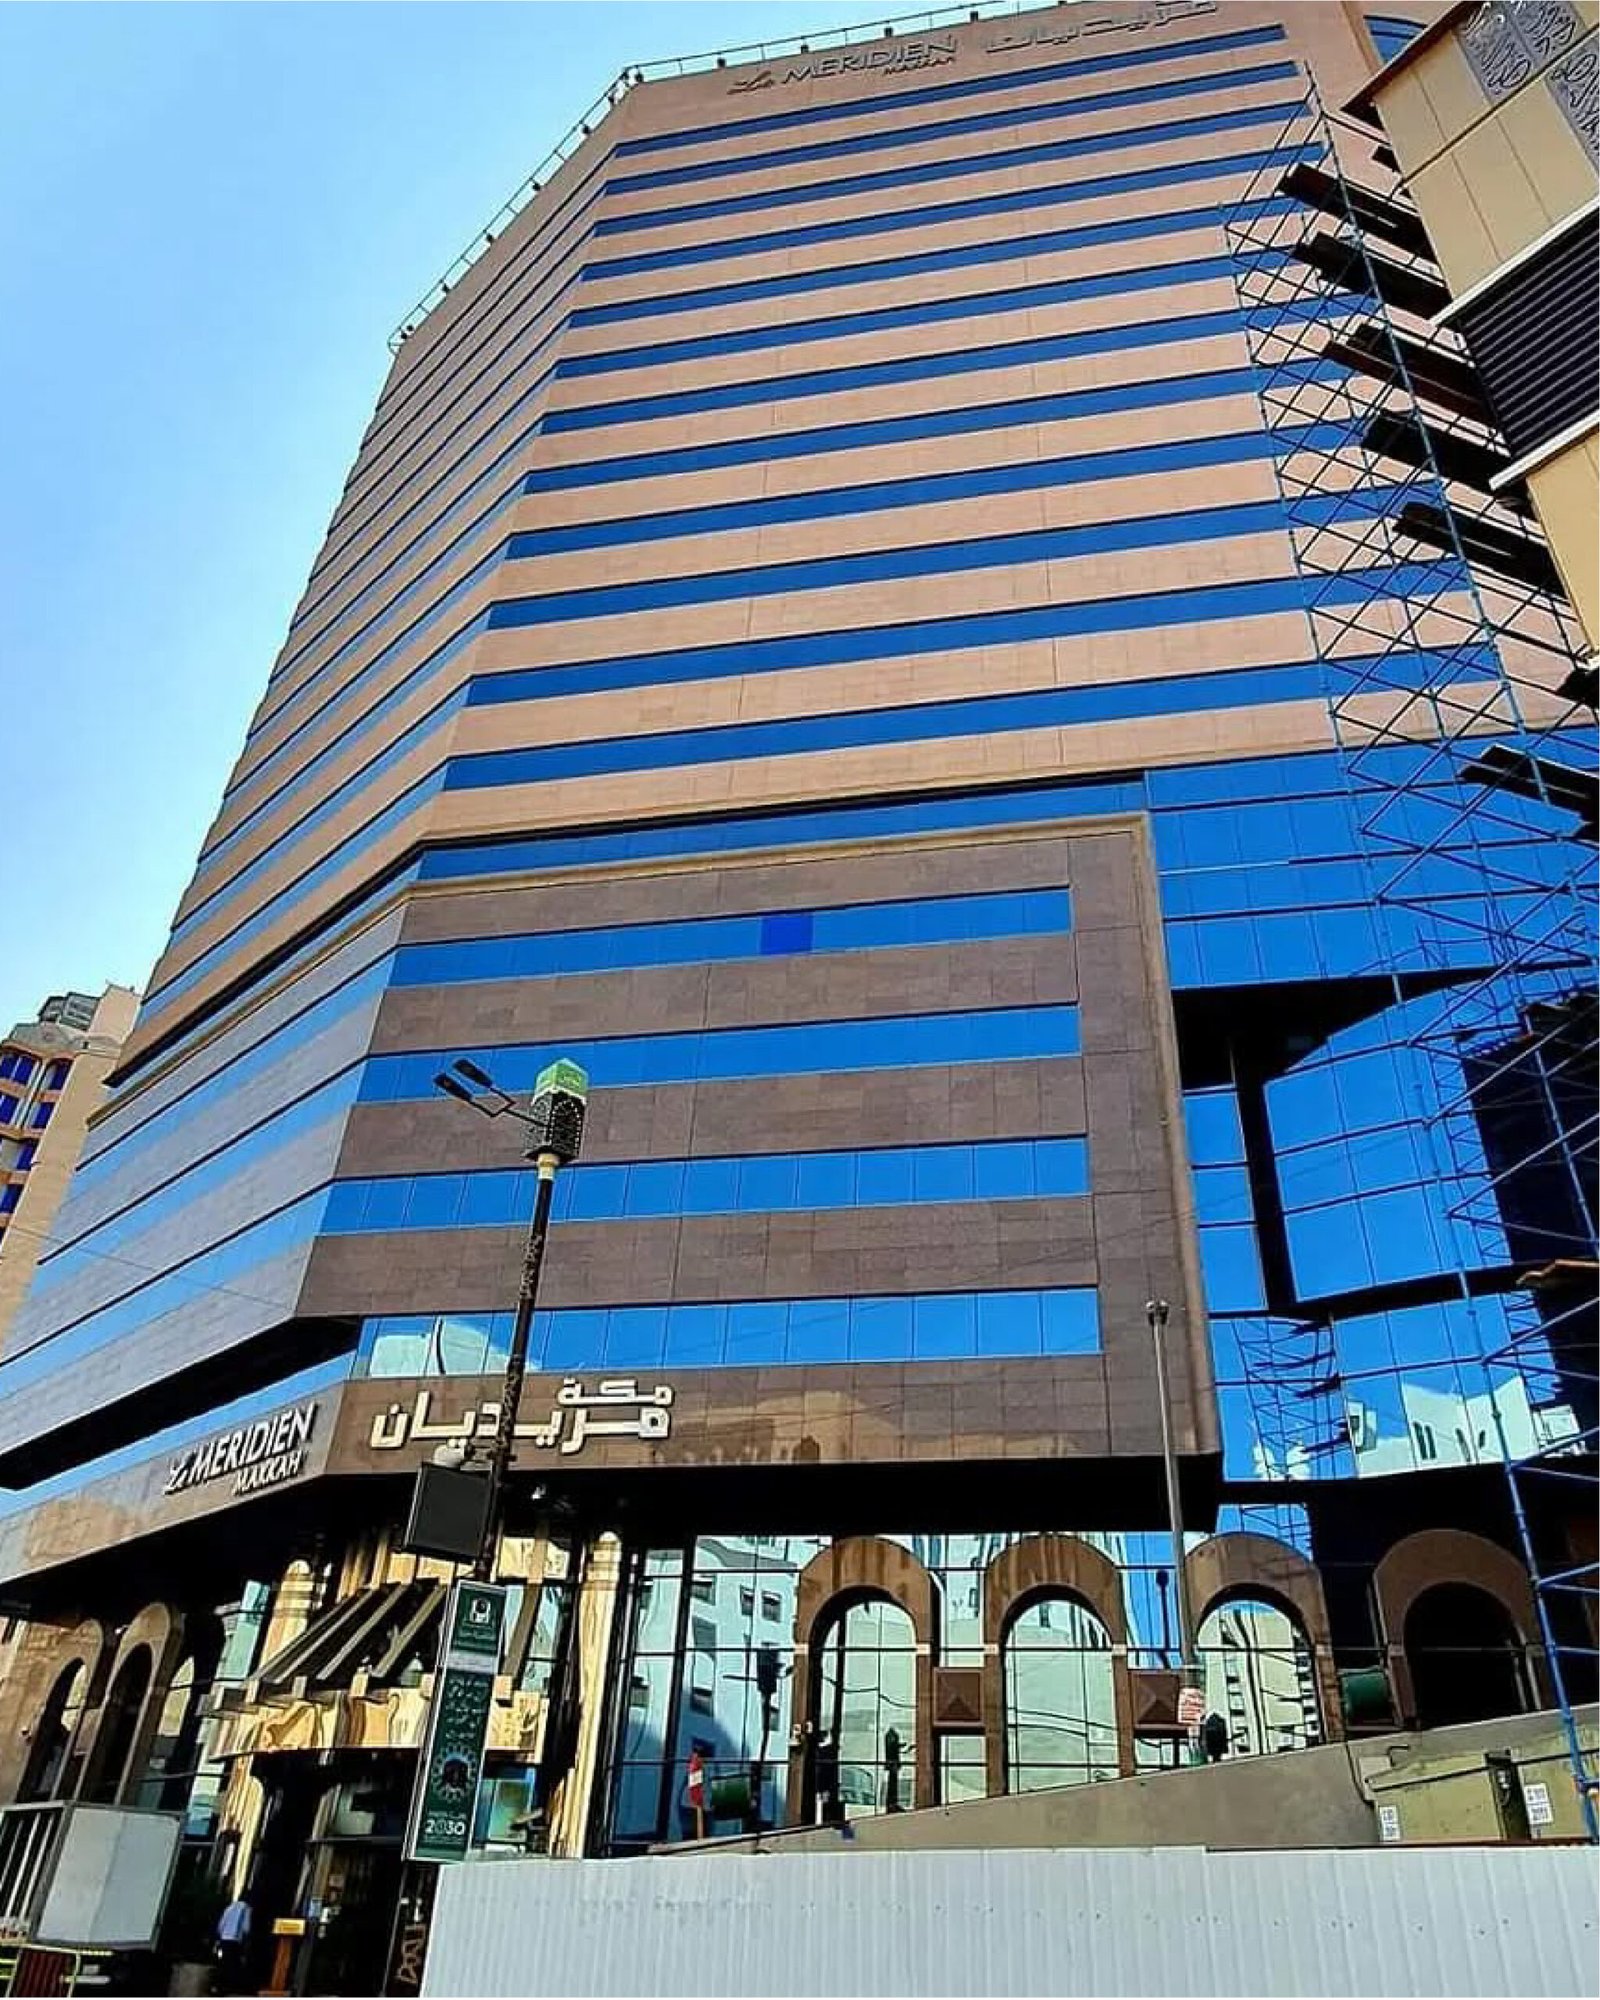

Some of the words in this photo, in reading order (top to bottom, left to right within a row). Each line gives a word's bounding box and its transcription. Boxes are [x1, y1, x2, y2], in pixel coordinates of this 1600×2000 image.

[782, 35, 957, 84] MERIDIEN
[557, 1376, 673, 1406] مكة
[188, 1401, 317, 1485] MERIDIEN
[370, 1390, 672, 1454] مريديان
[231, 1451, 306, 1496] MAKKAH
[425, 1818, 466, 1836] 2030
